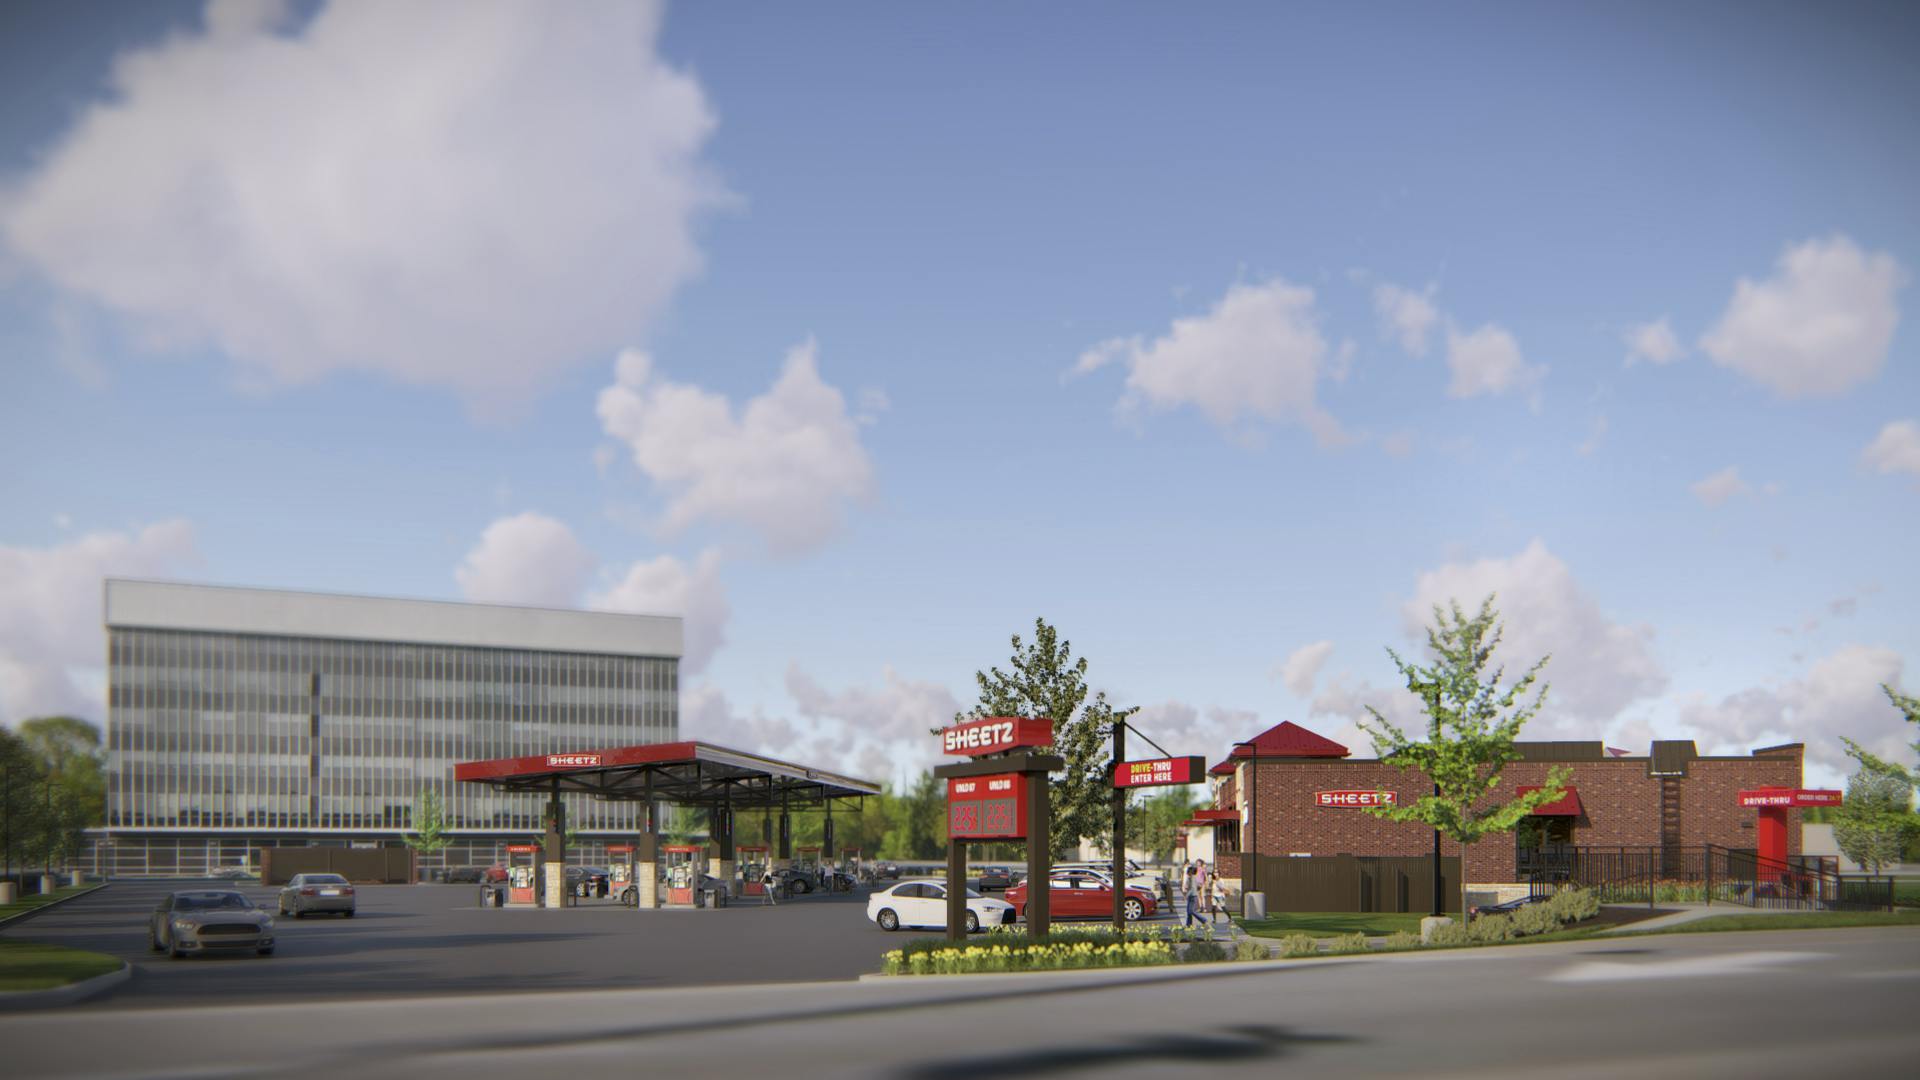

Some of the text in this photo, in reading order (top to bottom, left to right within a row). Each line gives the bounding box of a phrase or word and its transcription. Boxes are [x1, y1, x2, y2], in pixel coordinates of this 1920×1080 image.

[945, 721, 1013, 751] SHEETZ
[550, 756, 597, 765] SHEETZ
[1130, 761, 1172, 774] DRIVE-THRU
[1130, 771, 1172, 784] ENTER HERE
[1743, 796, 1791, 806] DRIVE-THRU
